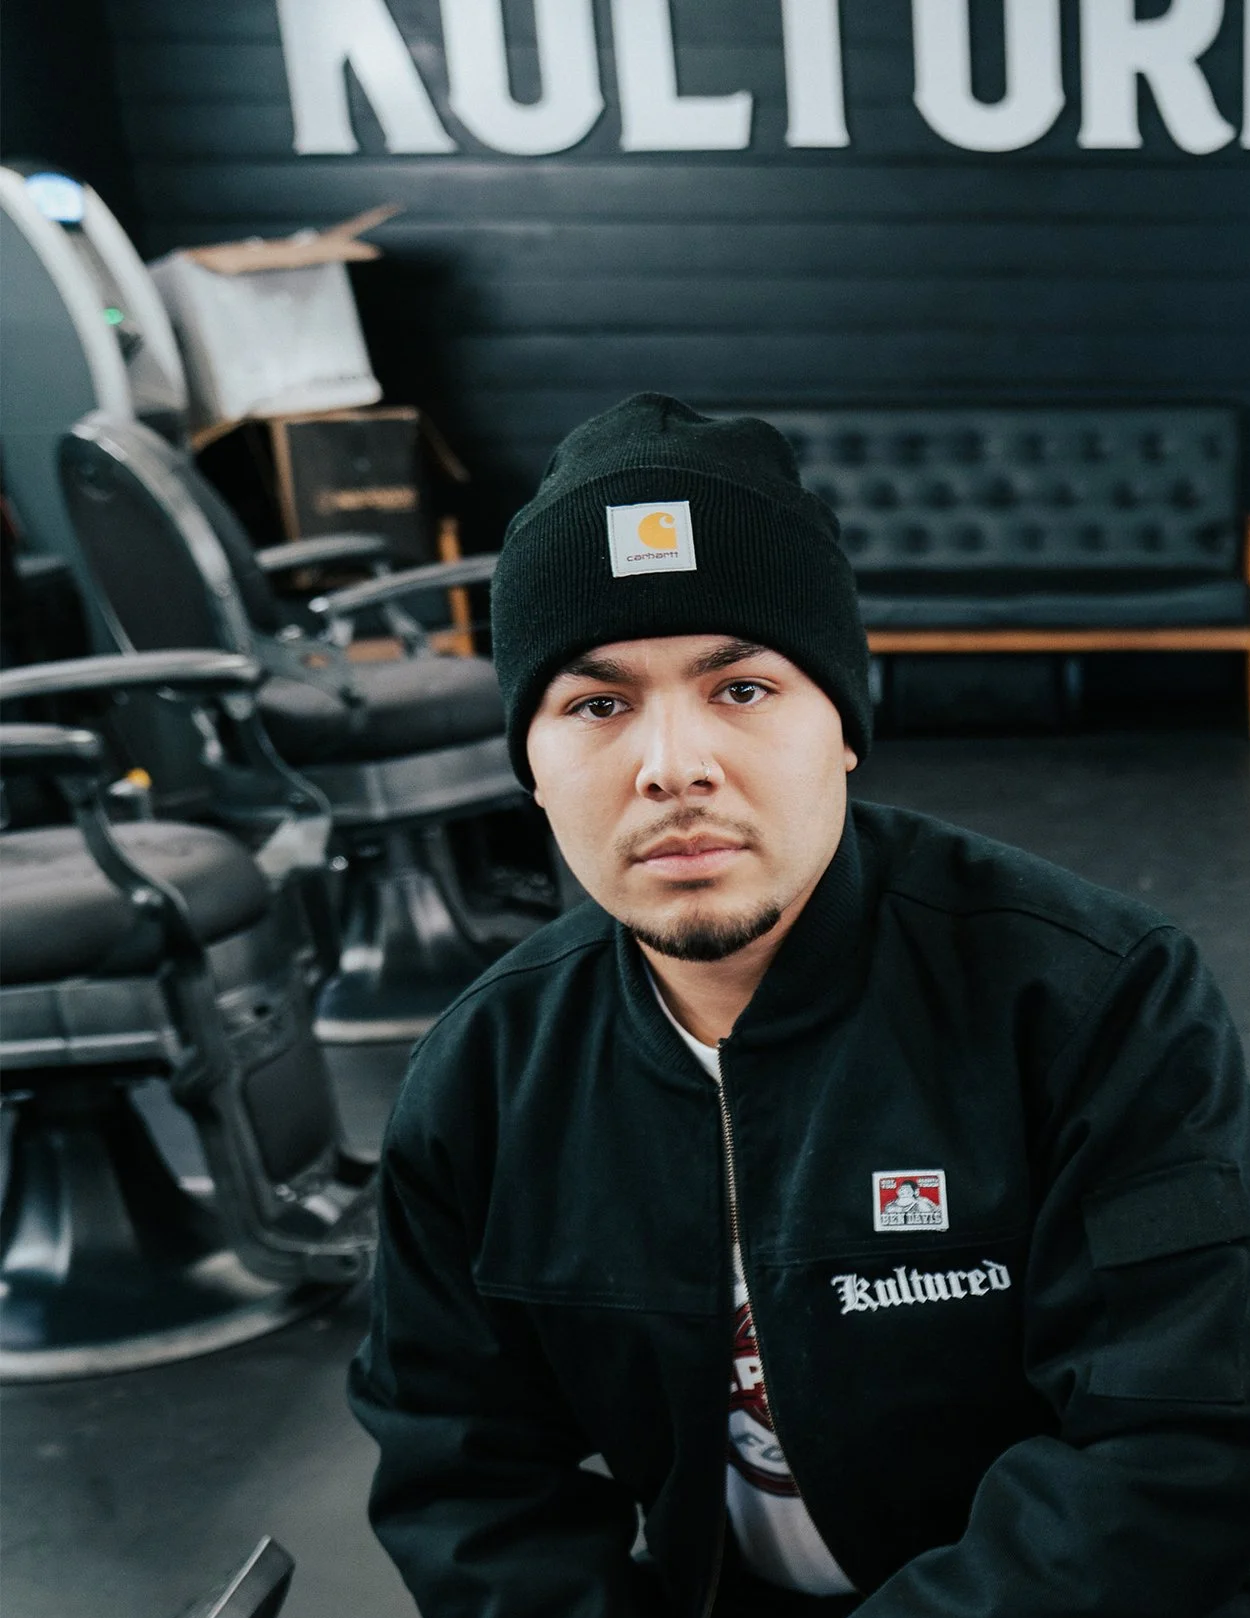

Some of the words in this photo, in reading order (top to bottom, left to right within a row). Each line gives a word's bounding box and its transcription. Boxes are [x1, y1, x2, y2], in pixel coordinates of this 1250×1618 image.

[626, 551, 679, 563] carhartt
[880, 1213, 904, 1226] BEN
[906, 1212, 943, 1225] DAVIS
[831, 1259, 1012, 1315] Kultured
